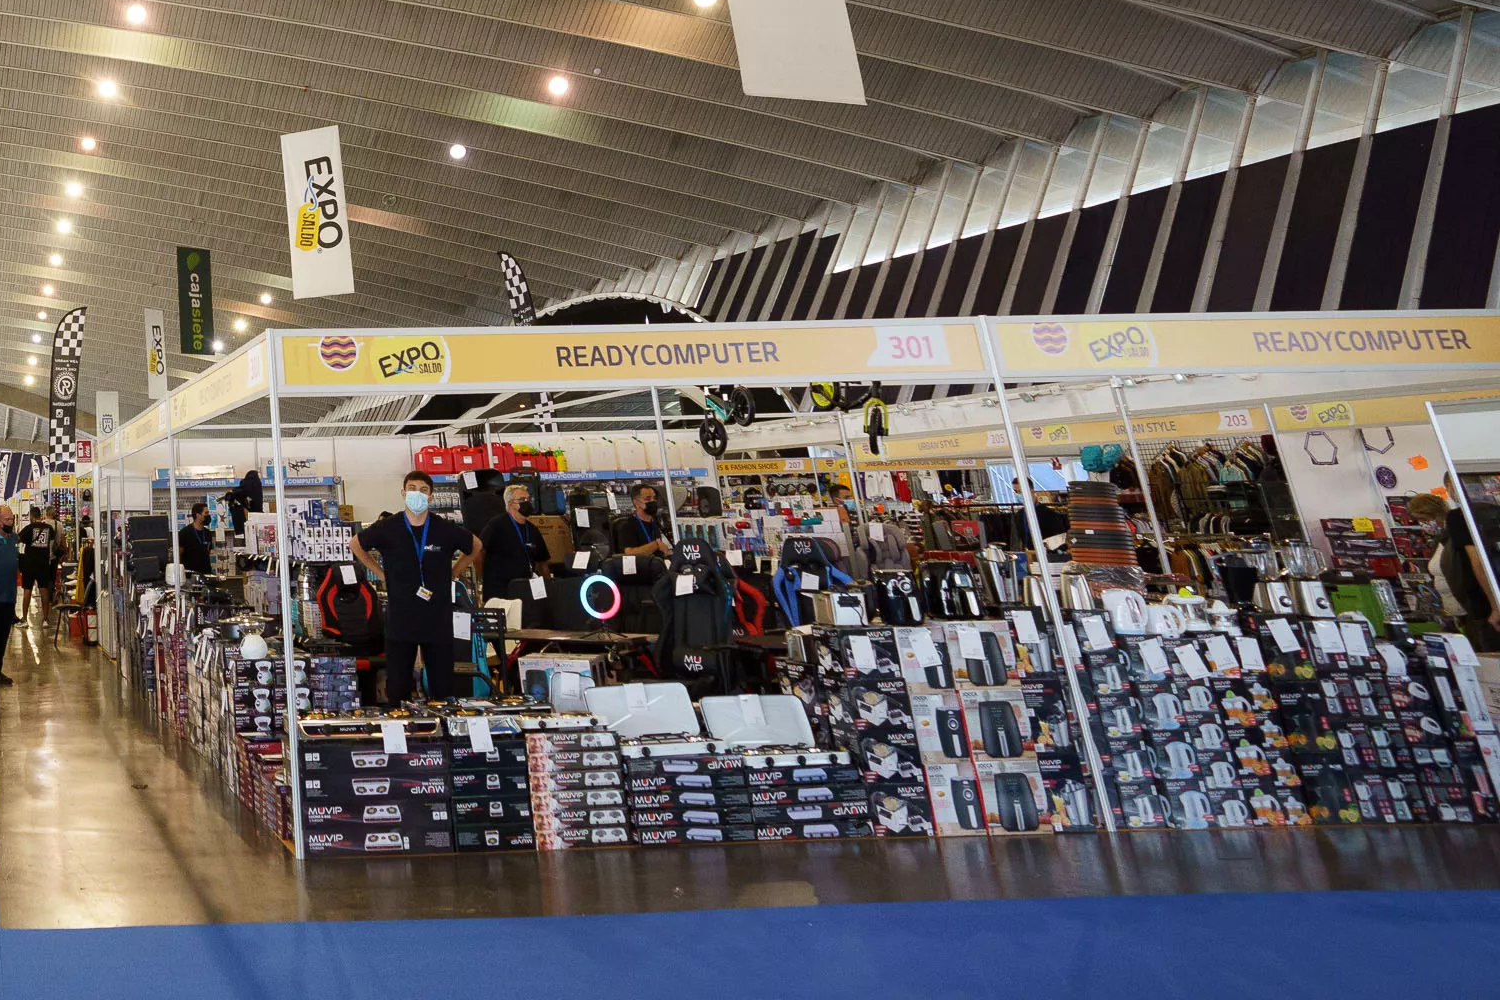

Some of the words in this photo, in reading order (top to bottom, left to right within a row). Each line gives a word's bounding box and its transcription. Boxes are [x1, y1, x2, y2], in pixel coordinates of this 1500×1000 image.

[304, 156, 343, 249] EXPO
[300, 213, 316, 248] SALDO
[190, 273, 203, 350] cajasiete
[1088, 326, 1145, 362] EXPO
[1253, 329, 1472, 352] READYCOMPUTER
[152, 325, 165, 375] EXPO
[556, 342, 780, 368] READYCOMPUTER
[888, 334, 934, 360] 301
[378, 341, 440, 378] EXPO
[418, 363, 442, 374] SALDO
[1316, 402, 1347, 424] EXPO
[1114, 424, 1145, 436] URAN
[1147, 421, 1176, 432] STYLE
[1224, 414, 1248, 427] 203
[1049, 426, 1068, 442] EXPO
[918, 442, 938, 450] URBAN
[940, 438, 960, 448] STYLE
[990, 434, 1005, 444] 205
[682, 544, 700, 553] MU
[794, 540, 810, 548] MU
[795, 546, 812, 554] VIP
[684, 552, 701, 560] VIP
[684, 654, 702, 664] MU
[685, 662, 704, 672] VIP
[409, 758, 443, 766] MUVIP
[707, 760, 742, 770] MUVIP
[749, 772, 782, 781] MUVIP
[632, 777, 666, 787] MUVIP
[410, 785, 444, 794] MUVIP
[634, 794, 670, 804] MUVIP
[752, 792, 787, 801] MUVIP
[308, 806, 343, 815] MUVIP
[833, 806, 868, 816] MUVIP
[638, 812, 674, 822] MUVIP
[642, 830, 676, 840] MUVIP
[758, 827, 792, 836] MUVIP
[309, 834, 344, 842] MUVIP
